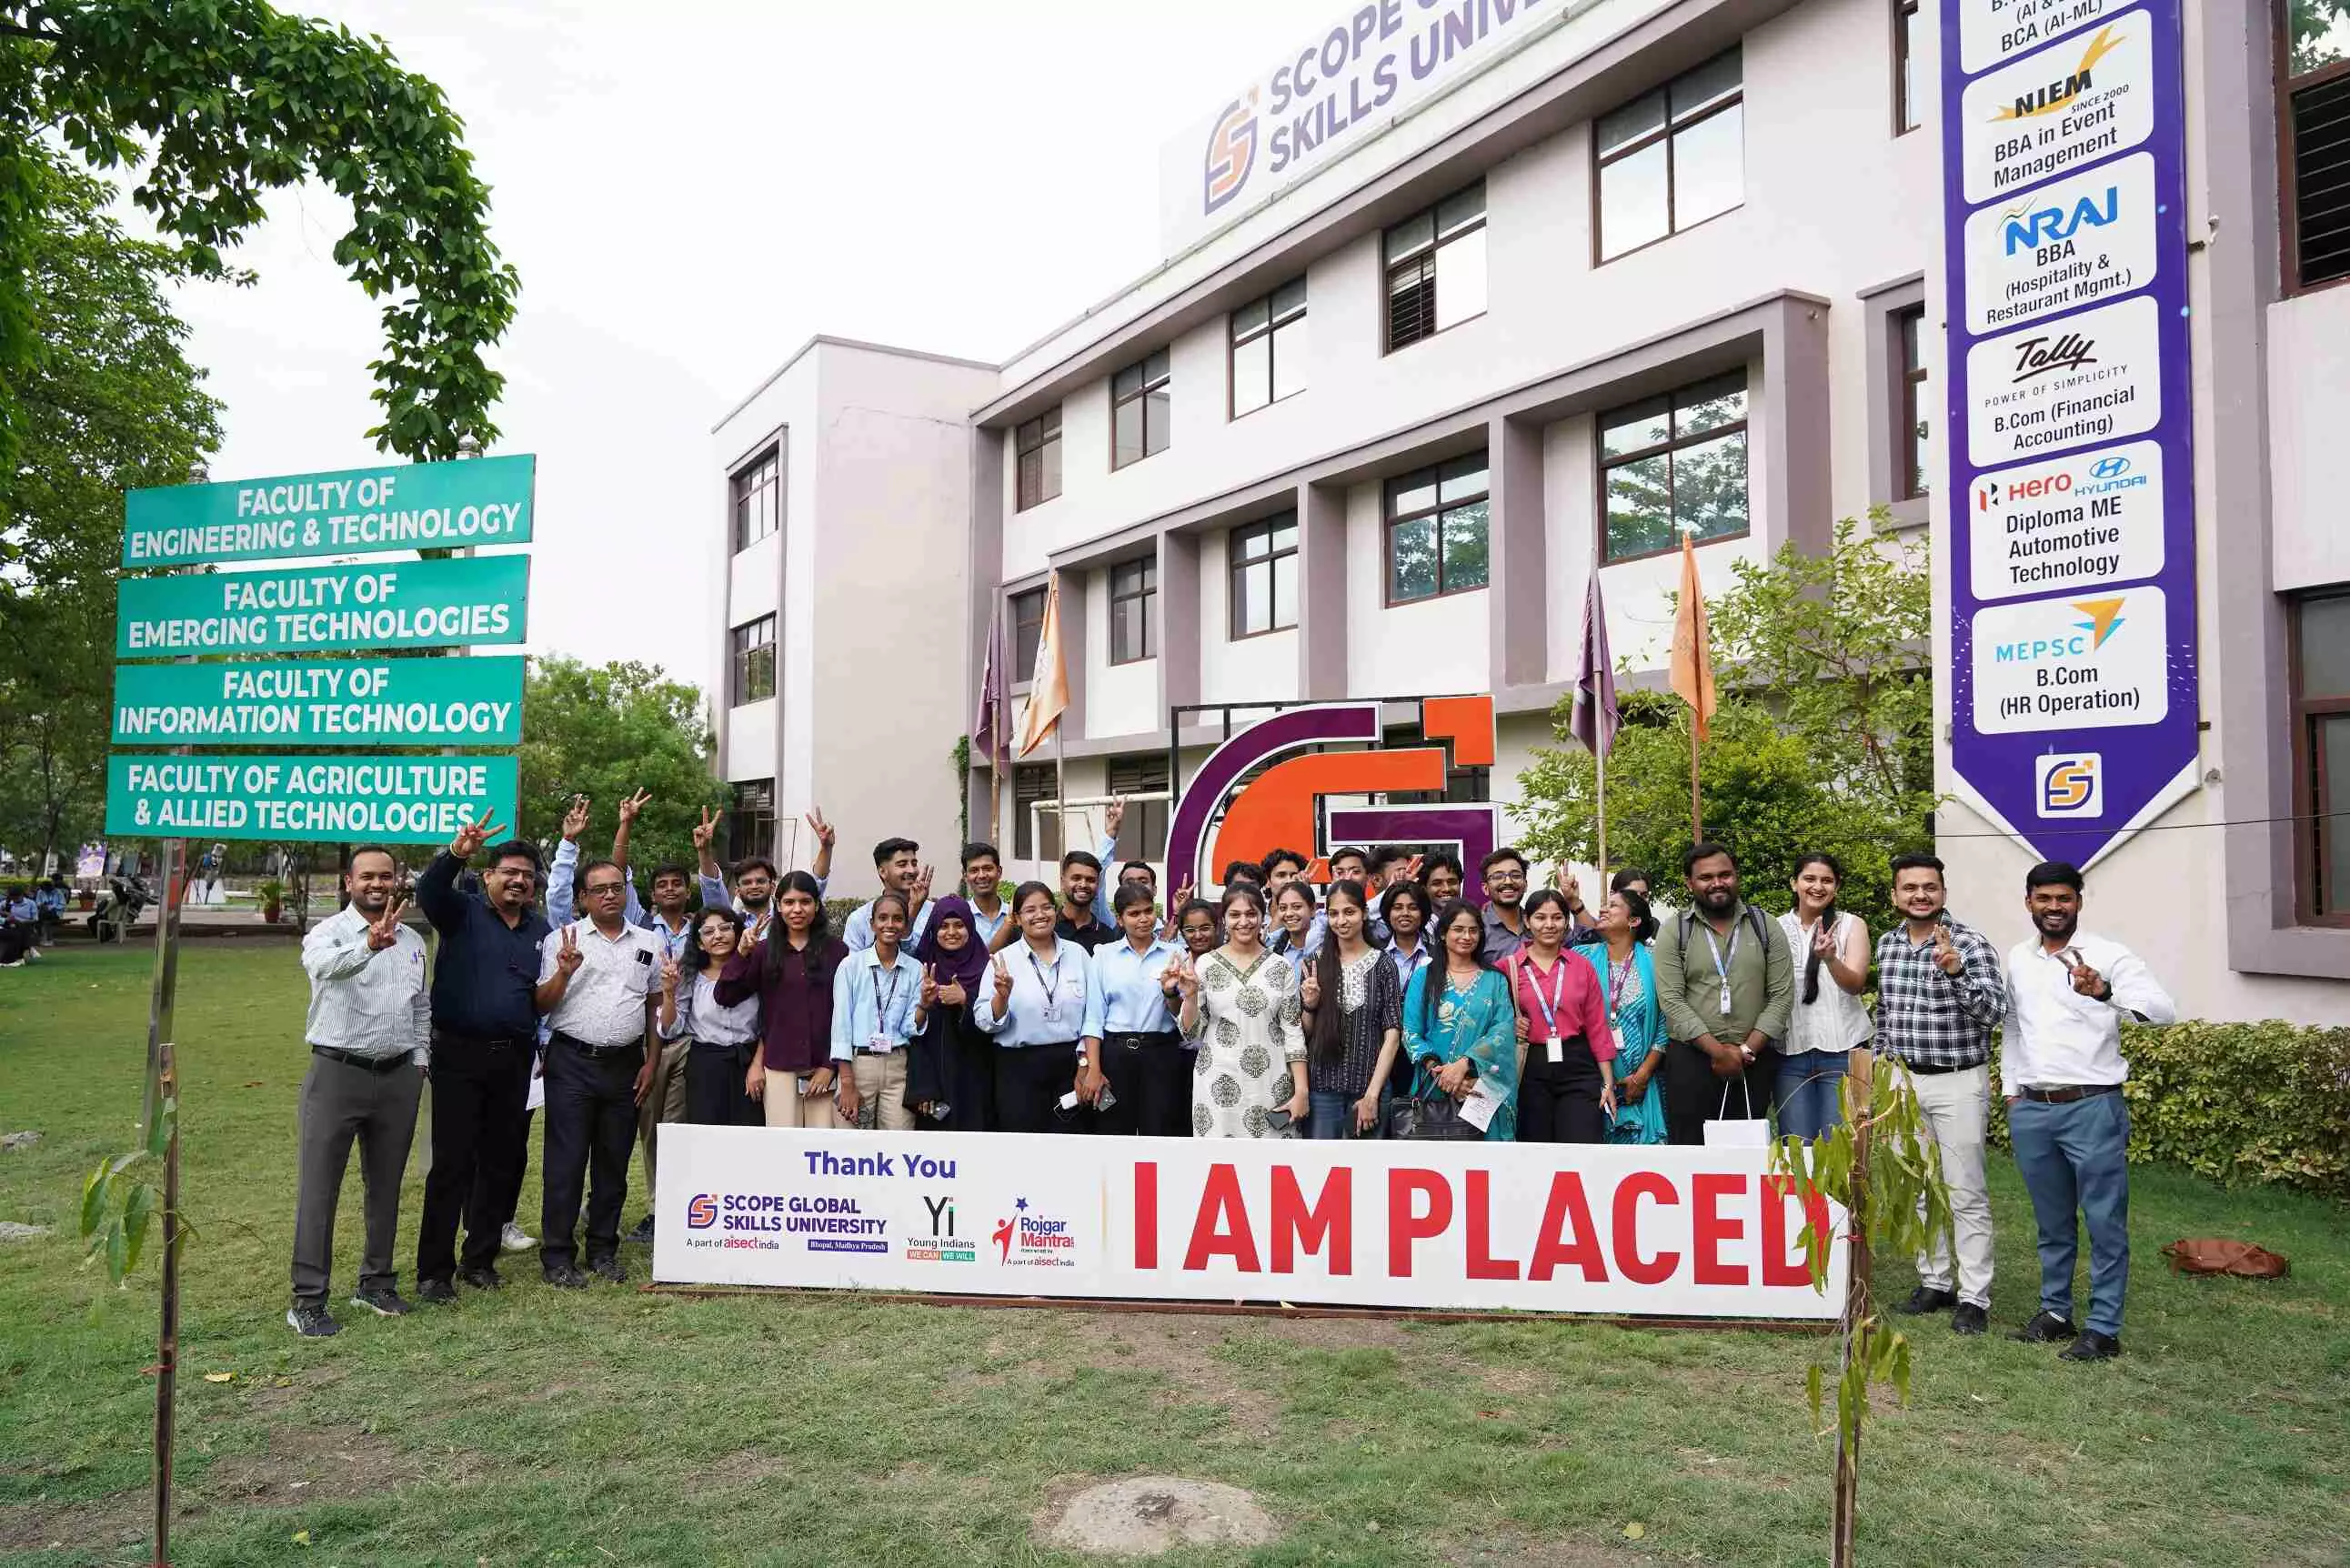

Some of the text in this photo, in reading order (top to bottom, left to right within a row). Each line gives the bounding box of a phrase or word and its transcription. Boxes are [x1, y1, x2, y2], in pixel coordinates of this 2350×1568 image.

[2002, 0, 2103, 53] BCA (AI-ML)
[1270, 0, 1402, 115] SCOPE
[2014, 69, 2093, 118] NIEM
[2071, 85, 2129, 115] SINCE 2000
[1270, 54, 1398, 173] SKILLS
[1994, 100, 2116, 163] BBA in Event
[1994, 126, 2118, 188] Management
[2005, 186, 2117, 256] NRAI
[2036, 239, 2075, 266] BBA
[2005, 254, 2110, 300] (Hospitality &
[1986, 268, 2132, 324] Restaurant Mgmt.)
[2013, 333, 2097, 382] Tally
[1984, 365, 2128, 407] POWER OF SIMPLICITY
[1994, 386, 2134, 433] B.Com (Financial
[2014, 415, 2114, 450] Accounting)
[238, 477, 395, 517] FACULTY OF
[2074, 475, 2146, 498] HYUNDAI
[131, 503, 521, 558] ENGINEERING & TECHNOLOGY
[2006, 496, 2122, 534] Diploma ME
[2009, 526, 2119, 559] Automotive
[2010, 554, 2120, 584] Technology
[224, 574, 397, 610] FACULTY OF
[129, 604, 509, 648] EMERGING TECHNOLOGIES
[1996, 637, 2084, 662] MEPSC
[224, 668, 388, 699] FACULTY OF
[2037, 666, 2098, 687] B.Com
[119, 702, 510, 734] INFORMATION TECHNOLOGY
[2001, 688, 2140, 719] (HR Operation)
[128, 765, 487, 796] FACULTY OF AGRICULTURE
[135, 799, 474, 832] & ALLIED TECHNOLOGIES
[805, 1151, 956, 1179] Thank You
[724, 1195, 861, 1214] SCOPE GLOBAL
[724, 1215, 888, 1234] SKILLS UNIVERSITY
[1021, 1215, 1067, 1235] Rojgar
[1134, 1162, 1830, 1286] I AM PLACED
[687, 1239, 693, 1247] A
[695, 1239, 712, 1249] part
[714, 1238, 723, 1247] of
[908, 1238, 975, 1249] Young Indians
[909, 1251, 939, 1260] WE CAN
[942, 1251, 974, 1261] WE WILL
